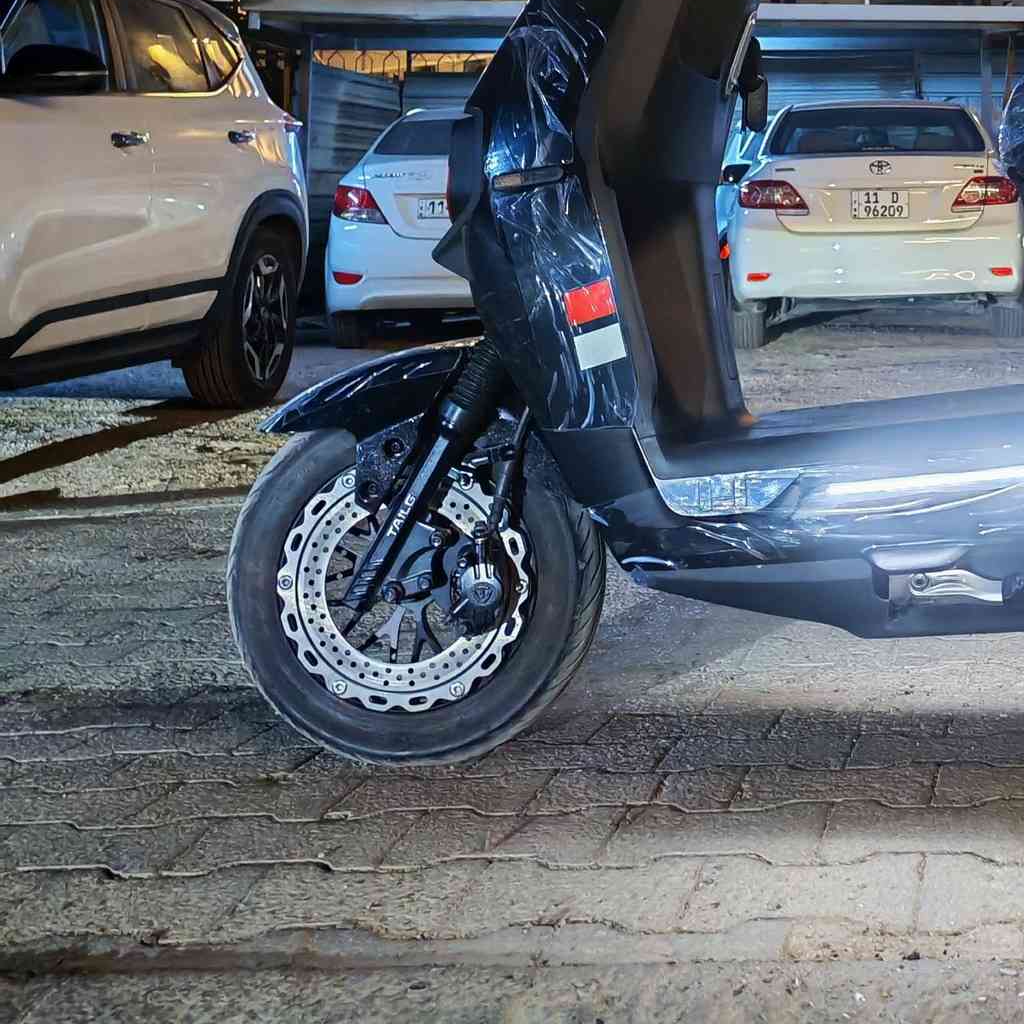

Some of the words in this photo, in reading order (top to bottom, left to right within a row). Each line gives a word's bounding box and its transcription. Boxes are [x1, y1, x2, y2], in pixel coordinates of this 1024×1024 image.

[864, 191, 879, 204] 11
[891, 191, 899, 204] D
[864, 205, 904, 217] 96209
[386, 493, 416, 537] TAILG
